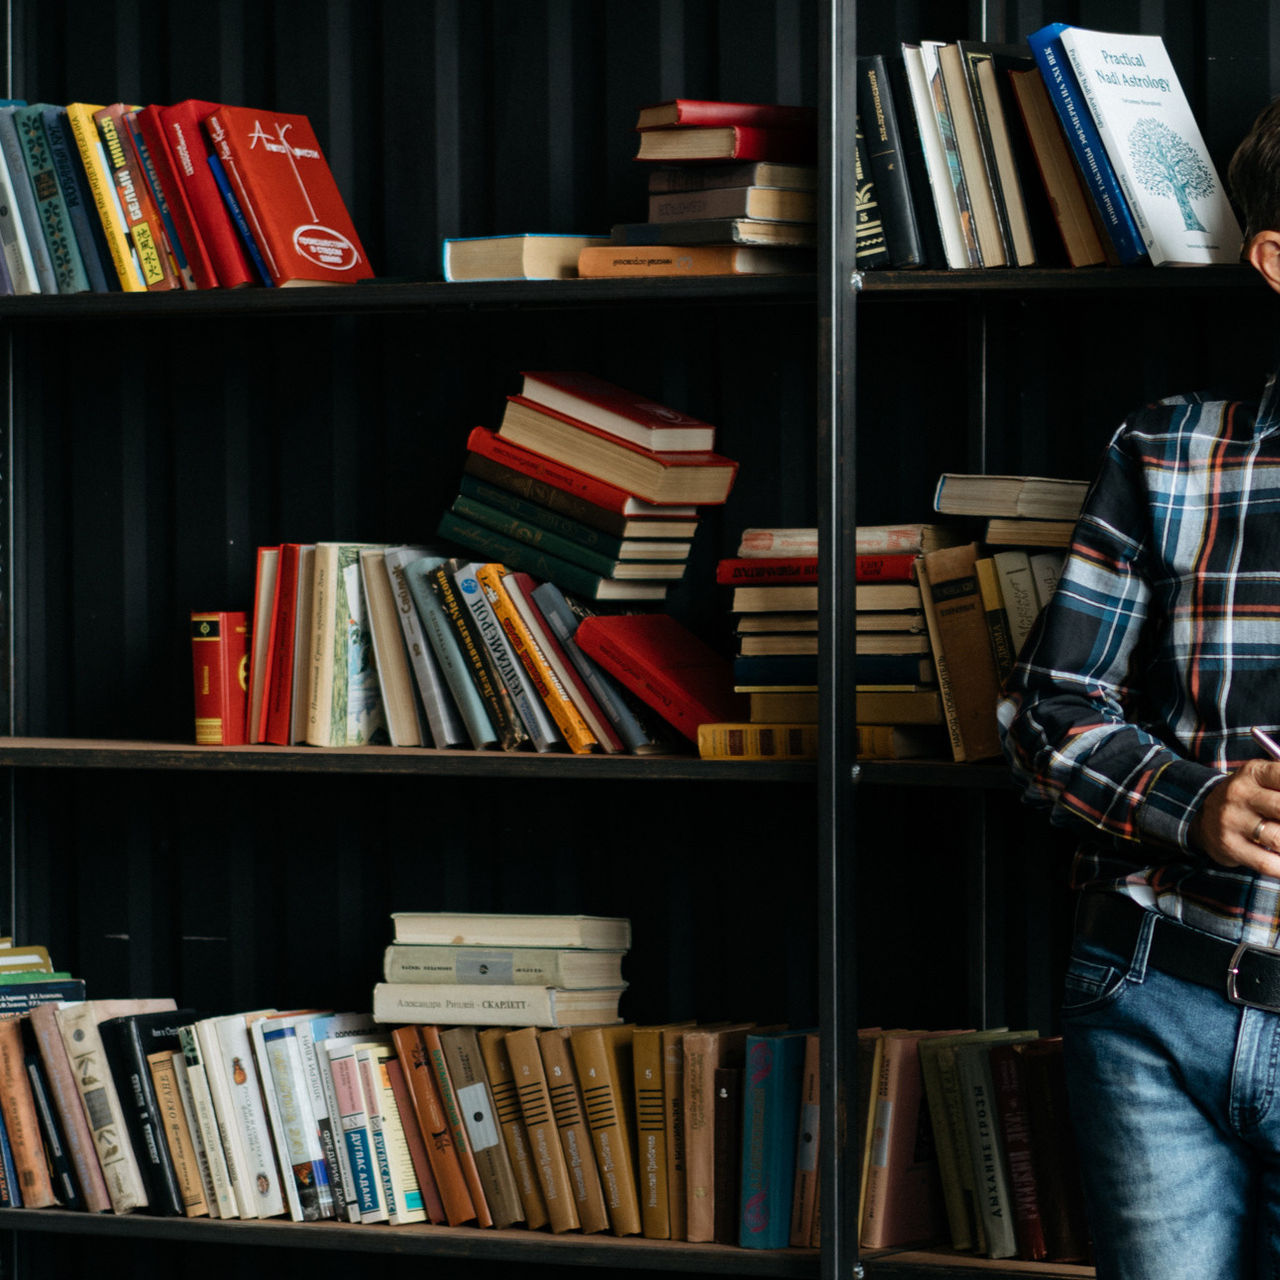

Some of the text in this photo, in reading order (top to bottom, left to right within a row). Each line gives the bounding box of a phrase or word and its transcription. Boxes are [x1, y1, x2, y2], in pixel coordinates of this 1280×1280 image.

[1095, 69, 1172, 93] Nadi Astrology
[1101, 50, 1146, 68] Practical
[100, 115, 143, 221] БЕЛЫЙ НИНДЗЯ
[1043, 47, 1119, 225] НОВЫЕ ТАБЛИЦЫ ЭФЕМЕРИД НА XXI ВЕК
[71, 115, 127, 276] Станислав МЫ ЖДЕМ РЕБЕНКА
[392, 563, 413, 614] Саймак
[436, 570, 495, 697] Дела адвоката Мейсона
[937, 654, 962, 748] НАРОД-ПОБЕДИТЕЛЬ
[322, 1129, 346, 1209] ФРЕДЕРИК ДАР
[351, 1133, 375, 1210] ДУГЛАС АДАМС
[372, 1134, 387, 1170] ДУГЛАС
[974, 1085, 1002, 1218] ДЫХАНИЕ ГРОЗЫ
